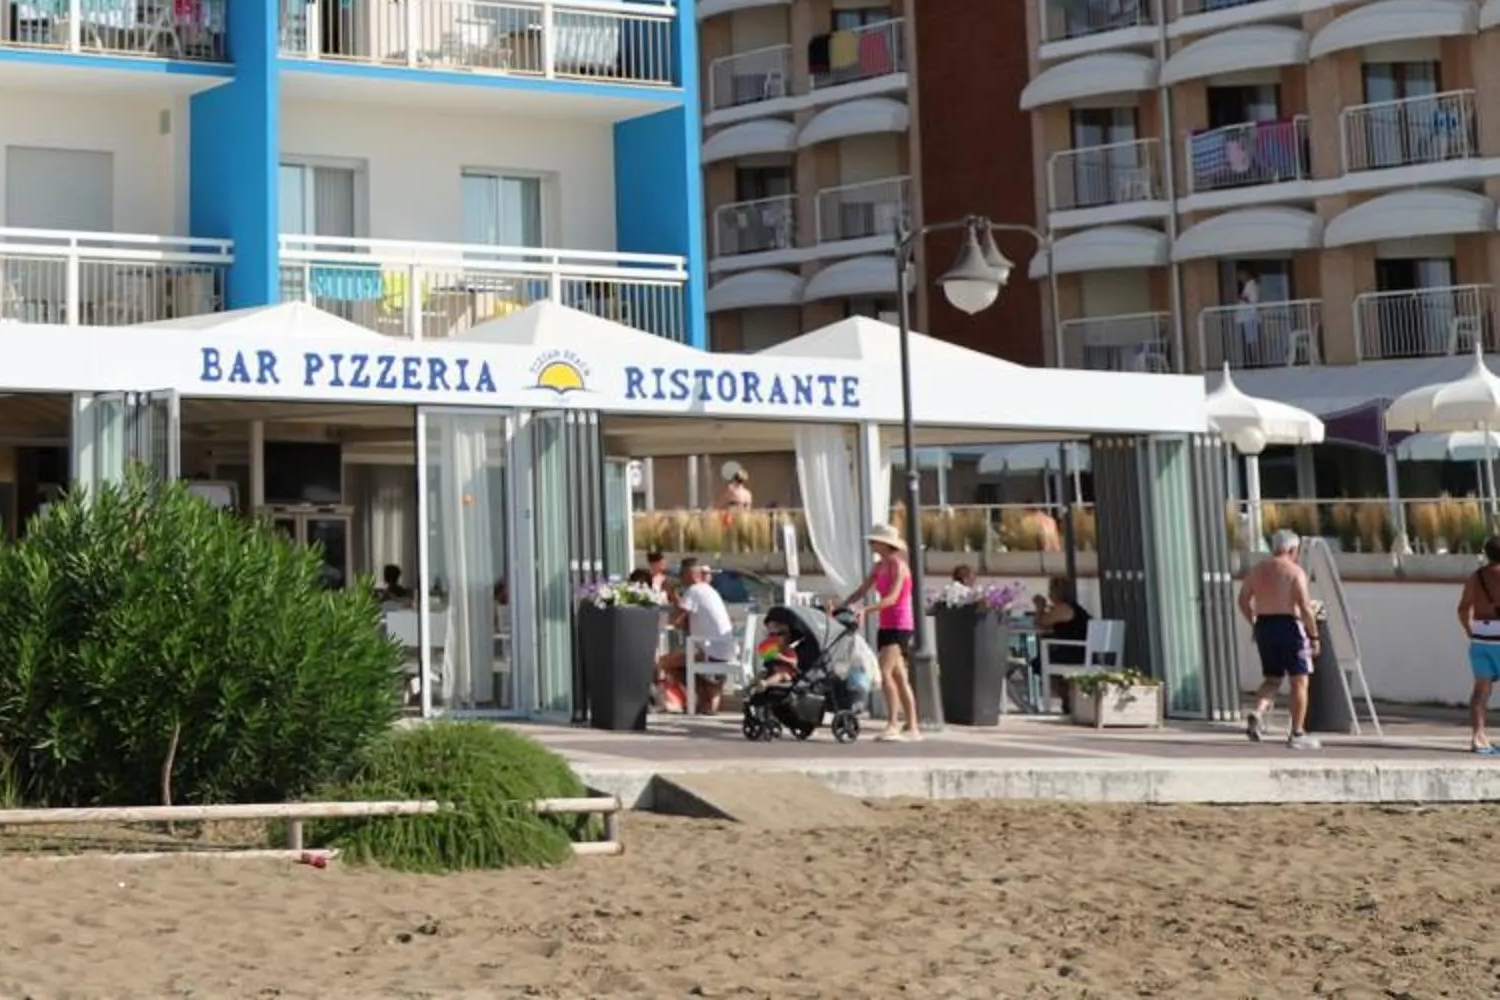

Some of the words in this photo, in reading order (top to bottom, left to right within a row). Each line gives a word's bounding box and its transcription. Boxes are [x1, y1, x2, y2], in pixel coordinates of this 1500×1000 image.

[200, 347, 281, 384] BAR
[303, 351, 497, 393] PIZZERIA
[626, 366, 860, 406] RISTORANTE
